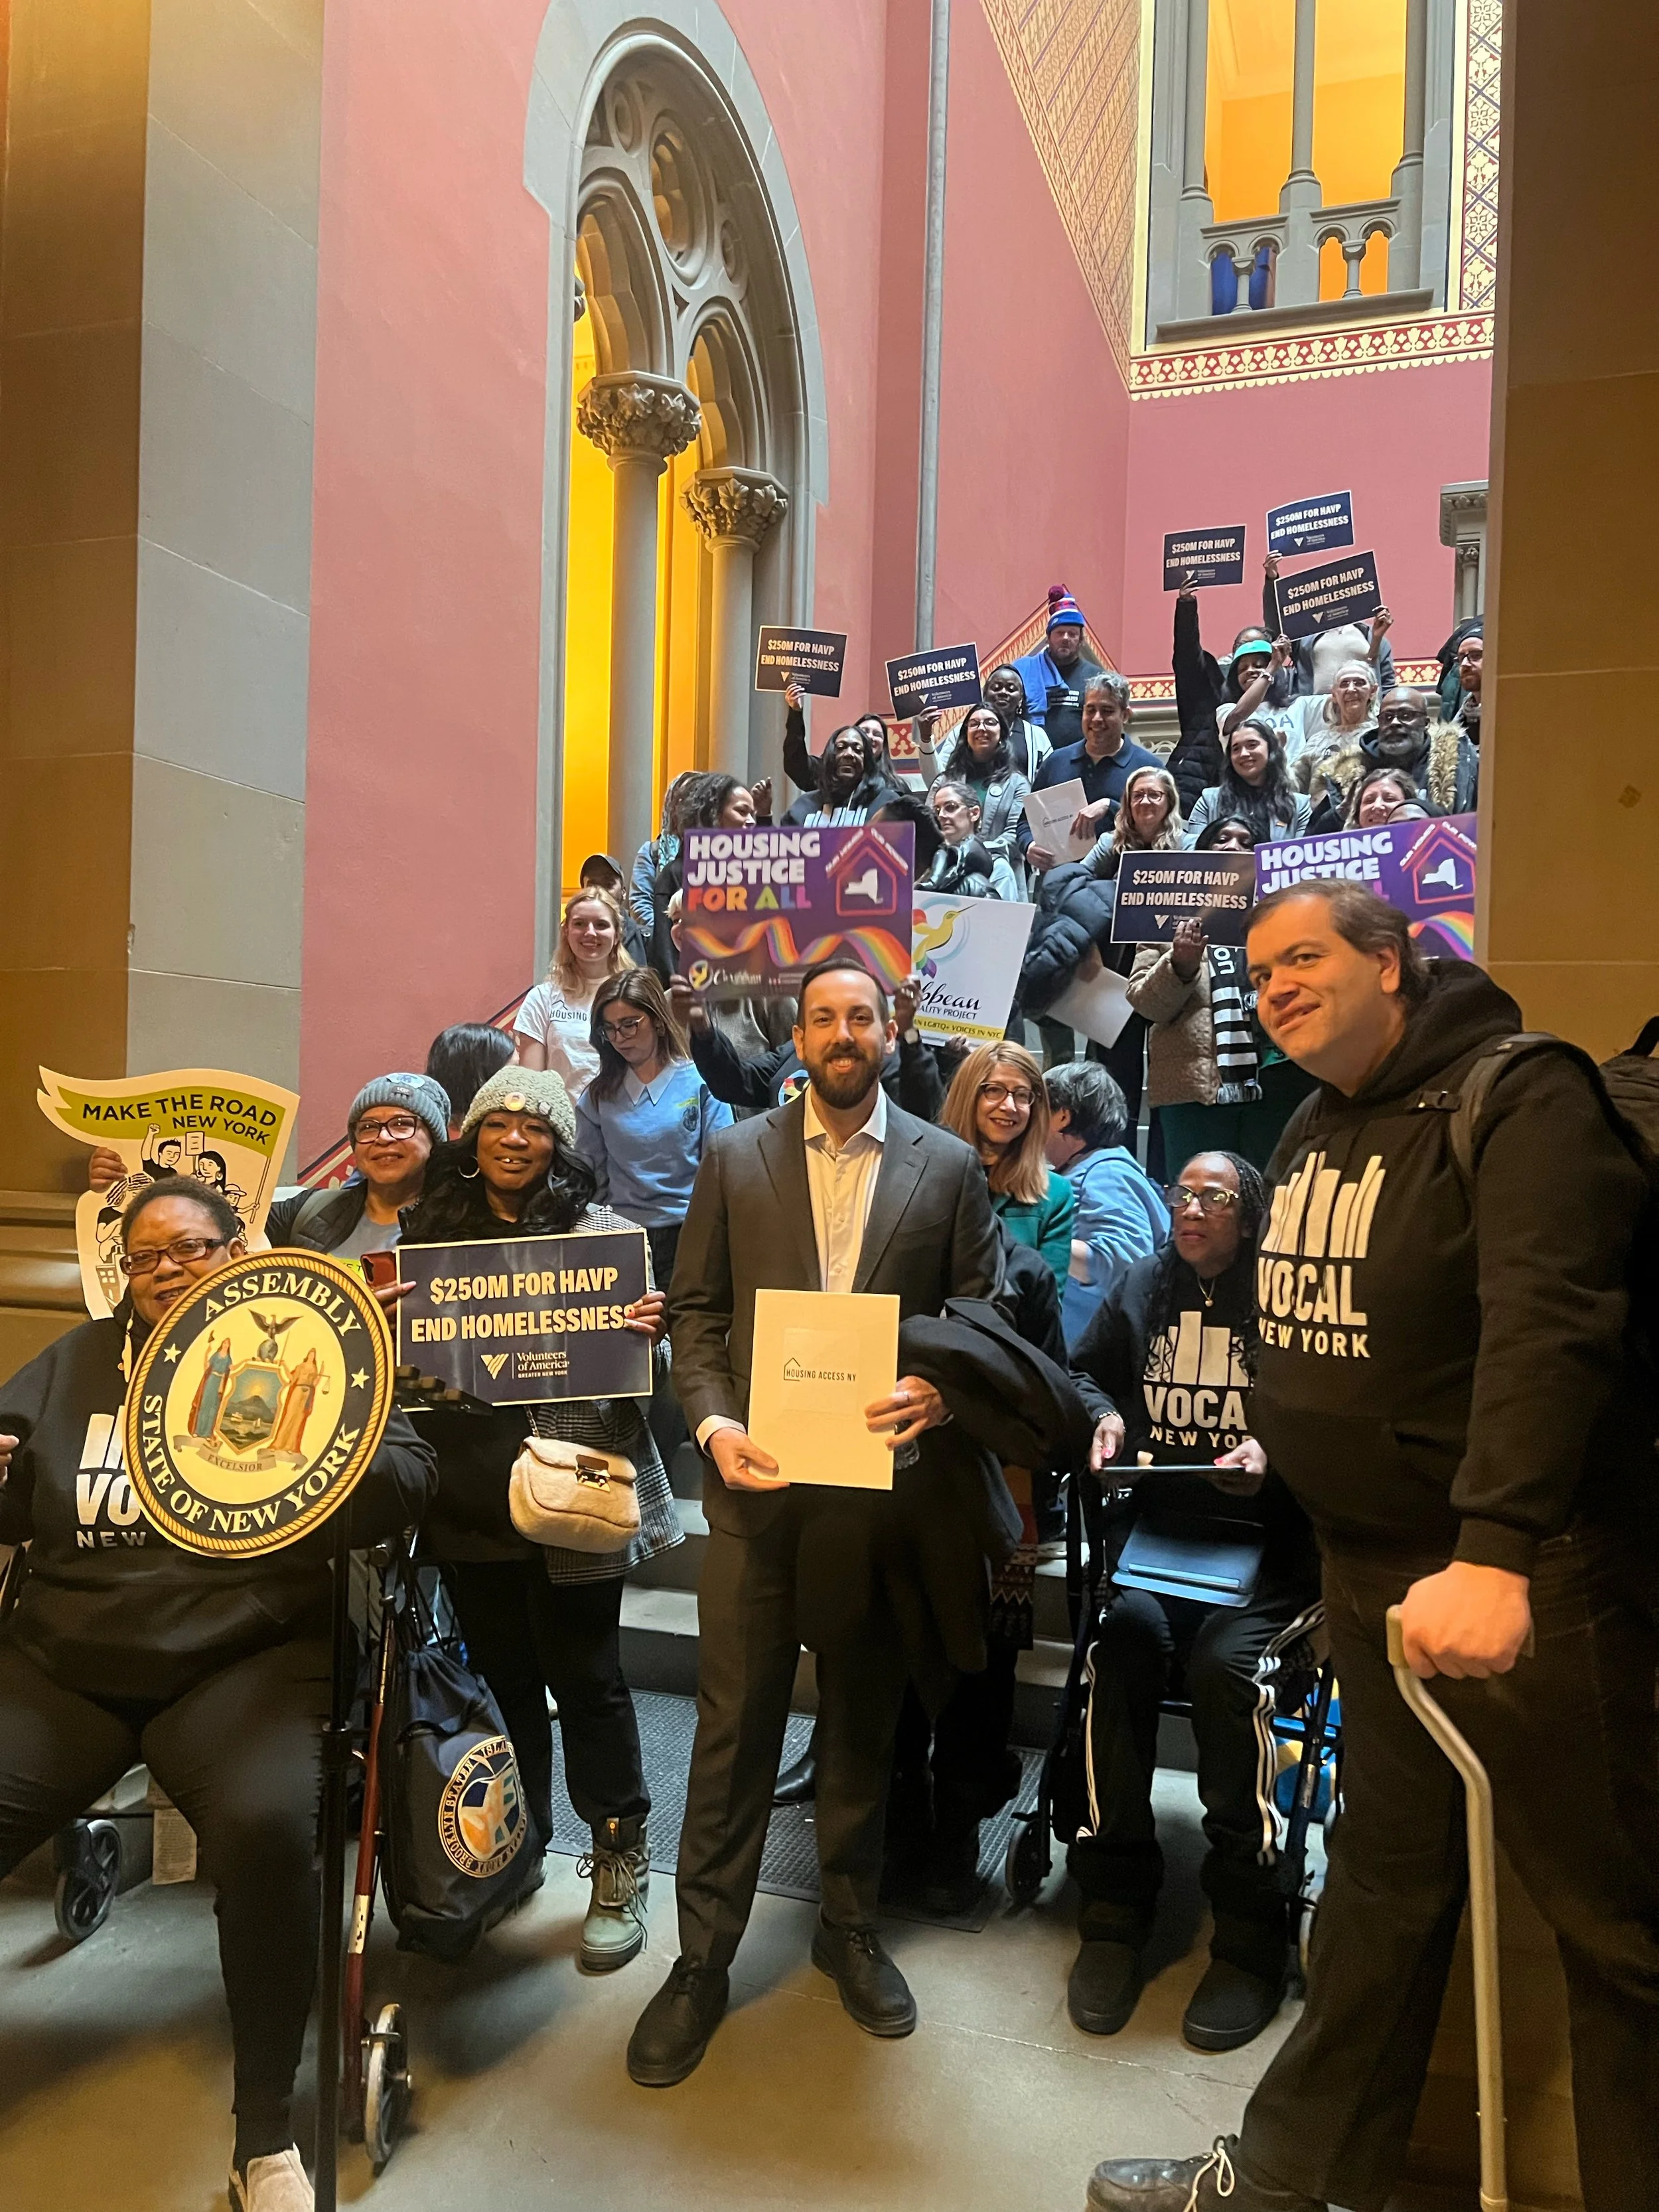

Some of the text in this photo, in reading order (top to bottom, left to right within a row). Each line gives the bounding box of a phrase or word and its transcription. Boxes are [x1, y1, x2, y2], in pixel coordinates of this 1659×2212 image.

[1271, 515, 1348, 540] END HOMELESSNESS
[1276, 504, 1341, 526] $250M FOR HAVP
[1172, 538, 1235, 553] $250M FOR HAVP
[1166, 552, 1240, 568] END HOMELESSNESS
[1287, 567, 1364, 599] $250M FOR HAVP
[1283, 581, 1374, 616] END HOMELESSNESS
[768, 639, 834, 656] $250M FOR HAVP
[761, 654, 839, 672] END HOMELESSNESS
[898, 658, 966, 680] $250M FOR HAVP
[894, 671, 975, 696] END HOMELESSNESS
[689, 831, 820, 859] HOUSING
[1261, 831, 1393, 871] HOUSING
[687, 858, 805, 886] JUSTICE
[1133, 869, 1240, 886] $250M FOR HAVP
[1262, 857, 1380, 894] JUSTICE
[687, 885, 812, 912] FOR ALL
[1121, 892, 1248, 910] END HOMELESSNESS
[1213, 946, 1235, 975] on
[922, 981, 982, 1010] bbean
[549, 1009, 587, 1021] HOUSING
[920, 1005, 977, 1020] ALITY PROJECT
[952, 1025, 975, 1035] VOICES
[986, 1031, 1001, 1039] NYC
[82, 1094, 277, 1126] MAKE THE ROAD
[172, 1115, 271, 1146] NEW YORK
[430, 1266, 618, 1305] $250M FOR HAVP
[1258, 1257, 1368, 1326] VOCAL
[204, 1272, 362, 1337] ASSEMBLY
[411, 1317, 457, 1342] END
[517, 1351, 567, 1361] Volunteers
[1301, 1328, 1371, 1358] YORK
[518, 1360, 568, 1371] of America
[786, 1369, 816, 1379] HOUSING
[818, 1371, 845, 1381] ACCESS
[1143, 1384, 1248, 1431] VOCA
[1149, 1426, 1198, 1446] NEW
[143, 1395, 360, 1534] STATE OF NEW YORK
[207, 1454, 263, 1471] EXCELSIOR
[76, 1473, 141, 1526] VO
[76, 1530, 147, 1548] NEW
[446, 1740, 508, 1807] STATEN ISLA
[444, 1811, 472, 1869] BROOKLYN
